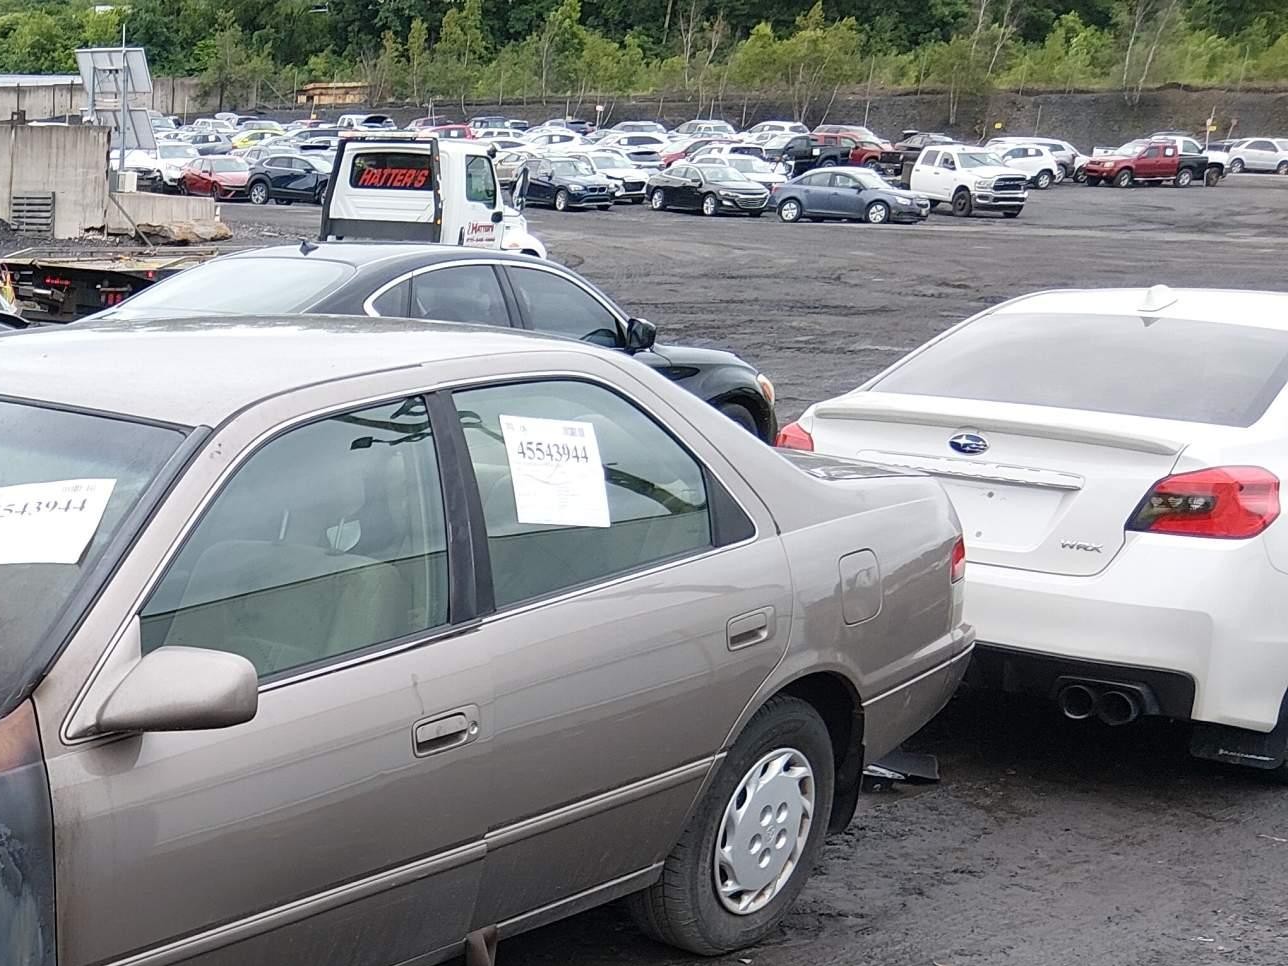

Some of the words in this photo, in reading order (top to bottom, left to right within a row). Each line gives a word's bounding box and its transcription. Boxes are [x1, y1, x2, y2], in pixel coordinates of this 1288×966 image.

[358, 168, 429, 187] HATTER'S
[517, 441, 589, 463] 45543944
[1061, 539, 1104, 553] WRX
